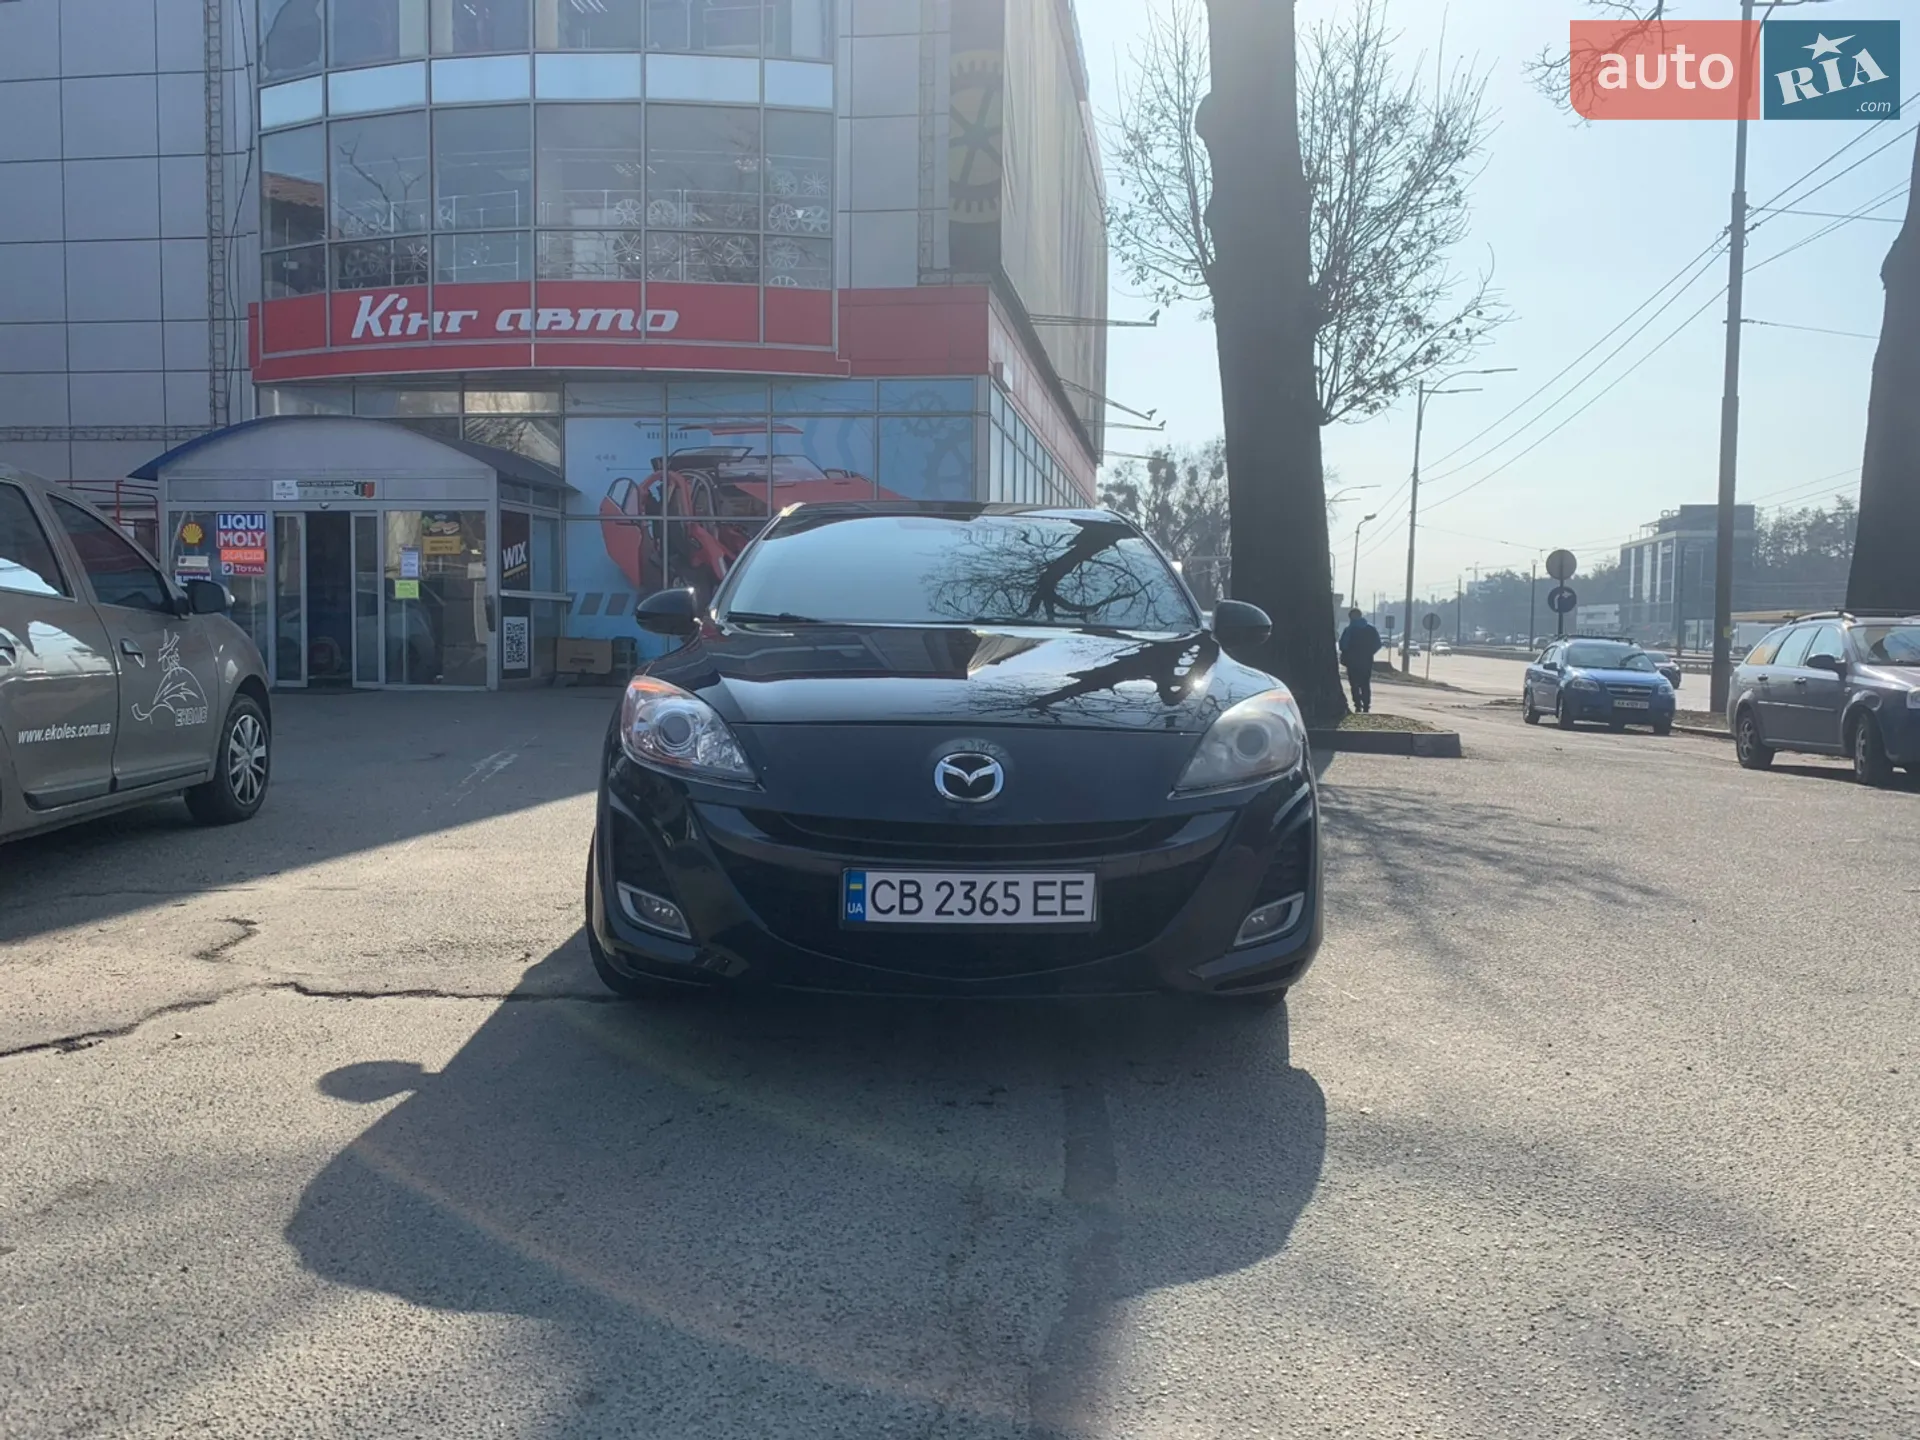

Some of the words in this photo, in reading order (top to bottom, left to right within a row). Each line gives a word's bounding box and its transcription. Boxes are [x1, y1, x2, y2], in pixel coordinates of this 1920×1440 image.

[351, 293, 478, 339] Кінг
[495, 307, 680, 333] авто
[219, 514, 263, 530] LIQUI
[219, 531, 265, 547] MOLY
[502, 541, 527, 570] WIX
[18, 722, 111, 744] www.ekoles.com.ua
[848, 903, 863, 914] UA
[870, 879, 924, 916] CB
[934, 880, 1021, 916] 2365
[1033, 880, 1085, 916] EE
